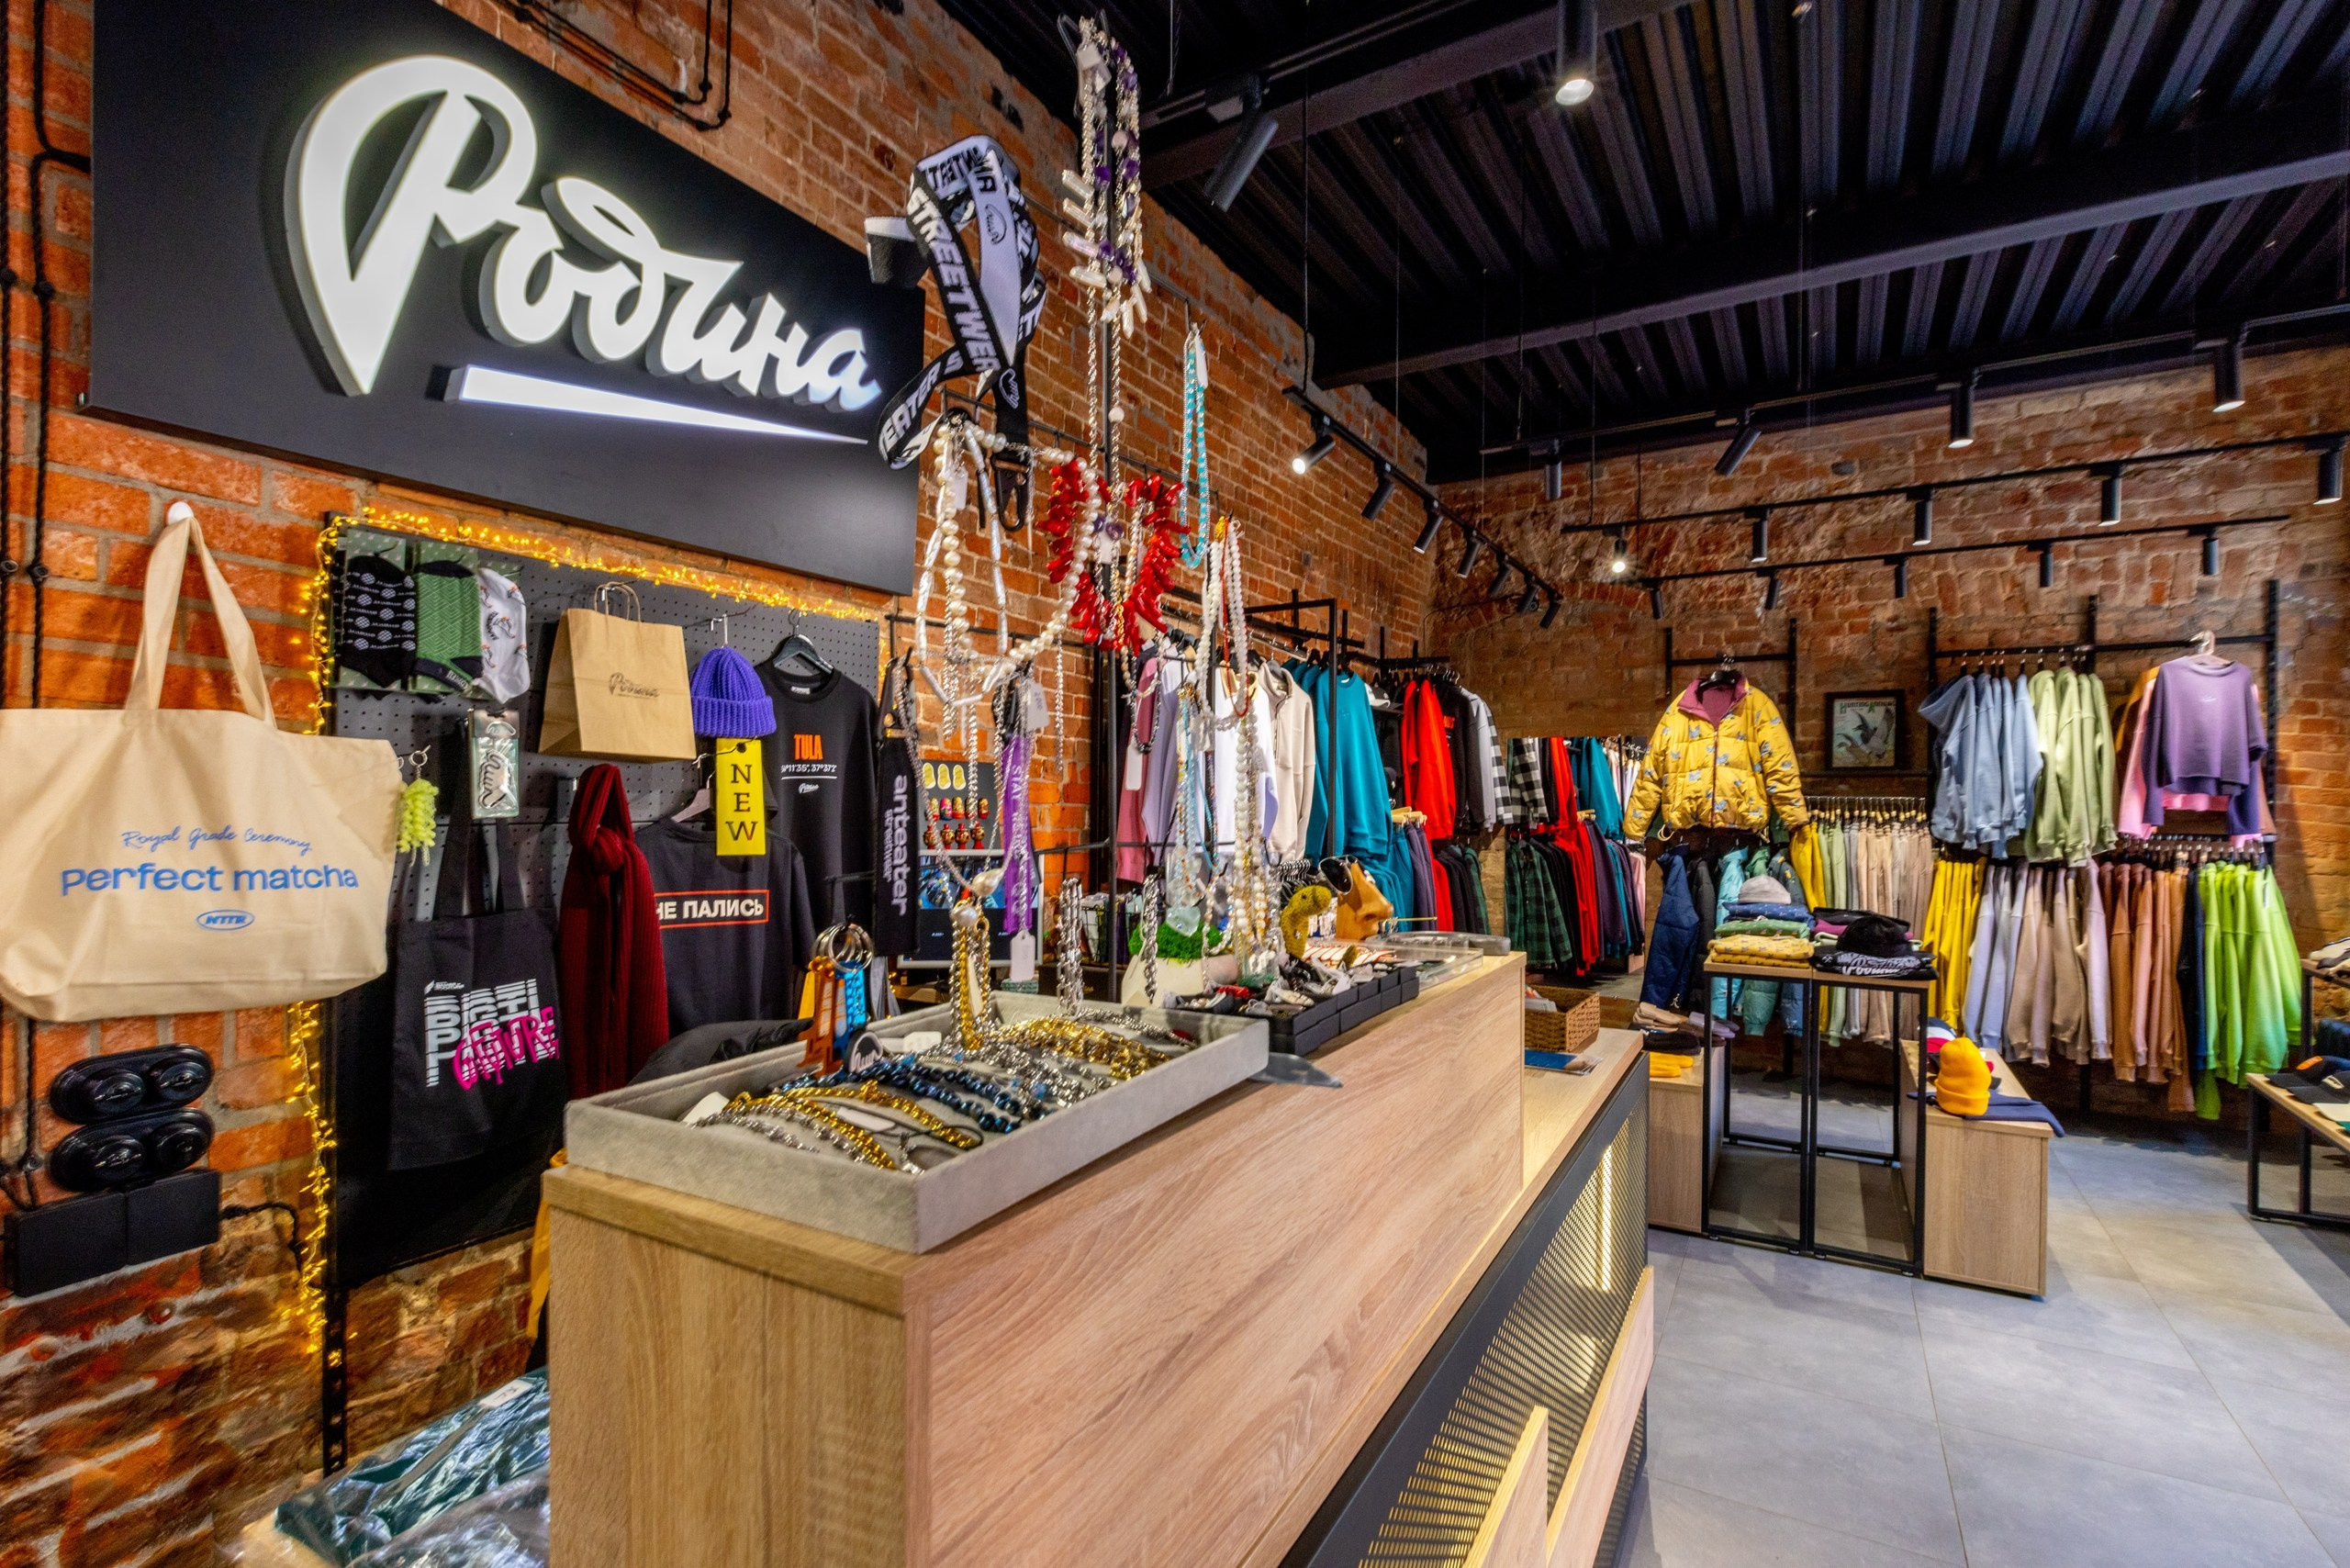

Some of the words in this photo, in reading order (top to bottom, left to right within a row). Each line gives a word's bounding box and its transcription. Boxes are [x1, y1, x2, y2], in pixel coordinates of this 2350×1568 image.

[286, 55, 881, 412] Родина
[793, 734, 823, 760] TULA
[725, 764, 758, 841] NEW
[121, 825, 181, 852] Royal
[188, 824, 238, 850] Grade
[243, 827, 313, 857] Ceremony
[891, 775, 911, 916] anteater
[62, 863, 224, 896] perfect
[233, 865, 359, 890] matcha
[683, 899, 765, 919] ПАЛИСЬ
